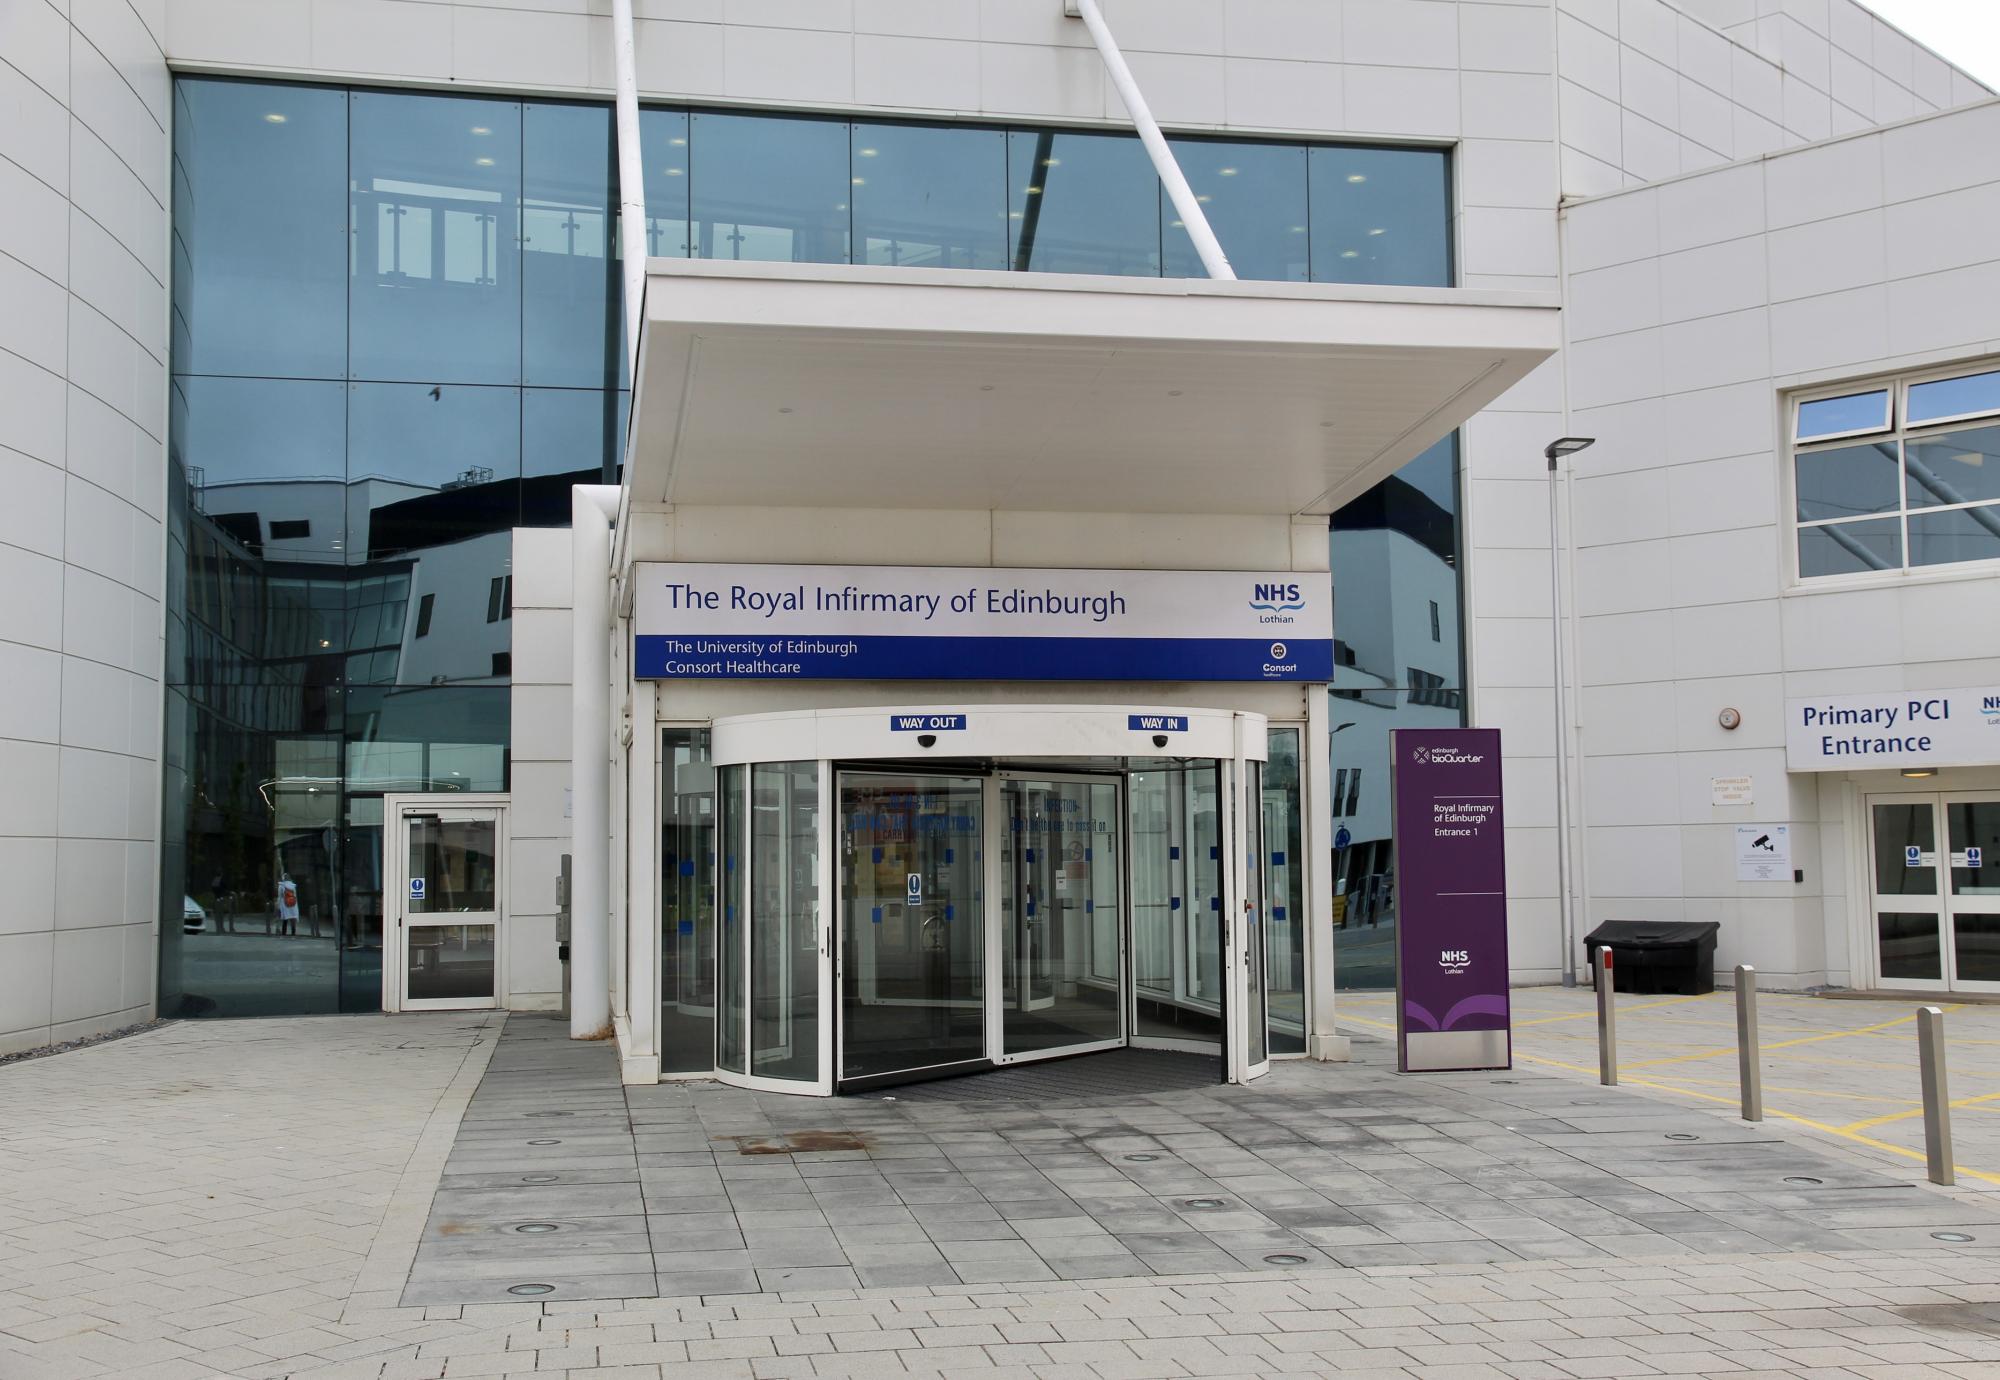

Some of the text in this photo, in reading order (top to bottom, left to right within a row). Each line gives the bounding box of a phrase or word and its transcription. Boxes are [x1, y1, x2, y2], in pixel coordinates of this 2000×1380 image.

[1254, 584, 1300, 601] NHS
[666, 584, 1126, 622] The Royal Infirmary of Edinburgh
[1259, 614, 1294, 624] Lothian
[666, 640, 858, 657] The University of Edinburgh
[666, 660, 800, 674] Consort Healthcare
[1263, 663, 1297, 672] Consort
[1803, 699, 1949, 728] Primary PCI
[900, 717, 957, 730] WAY OUT
[1141, 718, 1178, 730] WAY IN
[1822, 735, 1931, 755] Entrance
[1432, 754, 1484, 763] bioQuarter
[1434, 804, 1494, 814] Royal Infirmary
[1445, 814, 1486, 823] Edinburgh
[1435, 828, 1478, 836] Entrance 1
[1441, 950, 1468, 961] NHS
